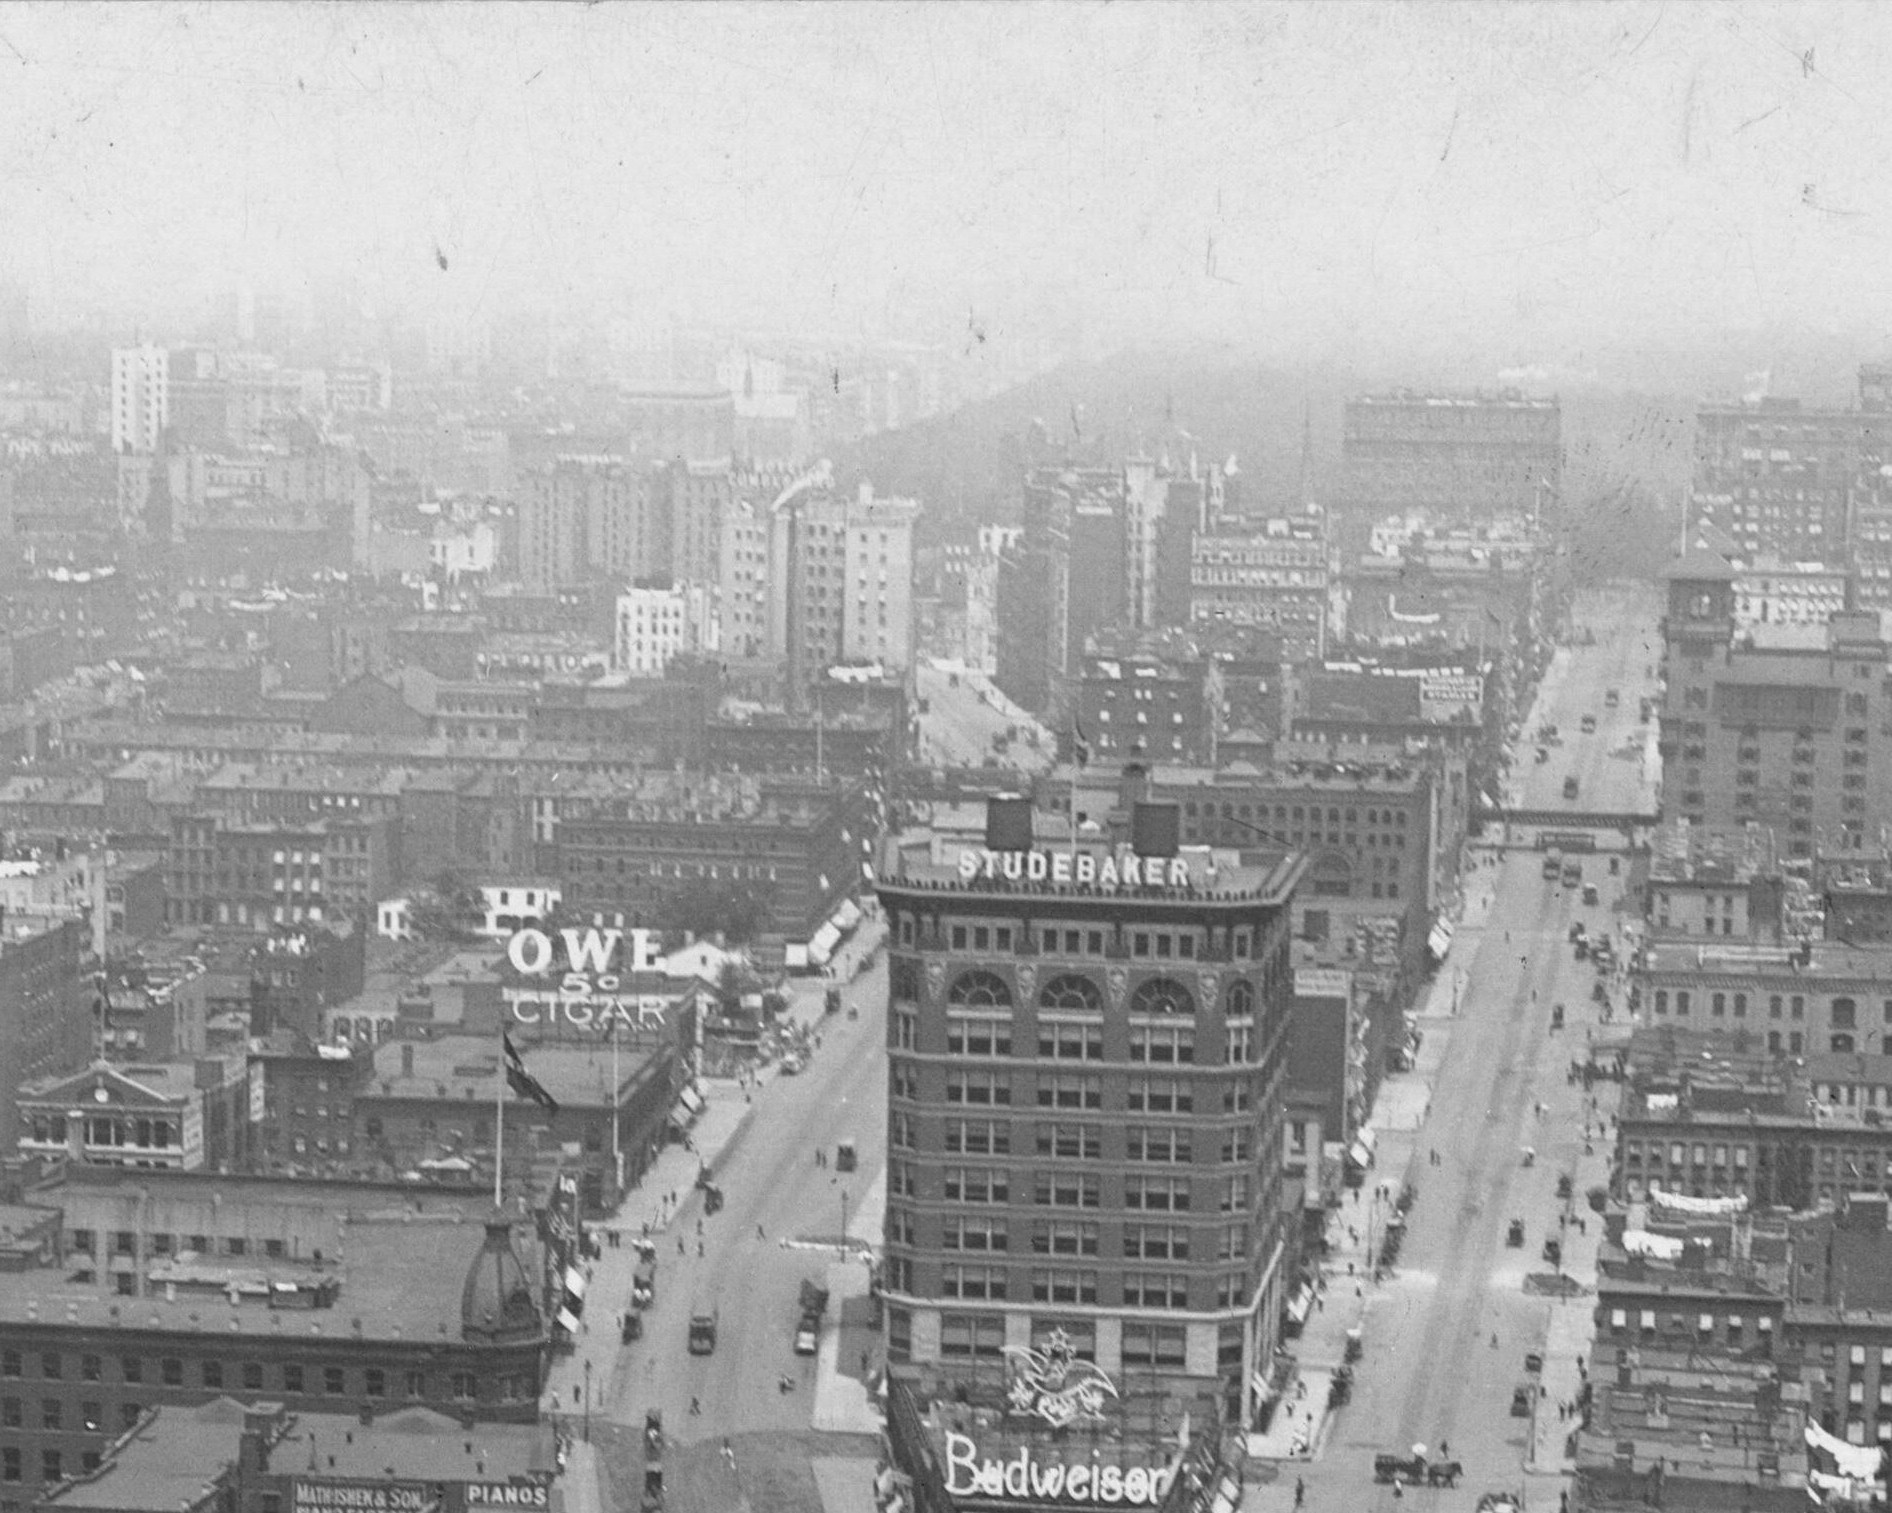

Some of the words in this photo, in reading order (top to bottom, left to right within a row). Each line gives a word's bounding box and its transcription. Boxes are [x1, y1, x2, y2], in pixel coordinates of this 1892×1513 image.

[959, 850, 1188, 886] STUDEBAKER
[512, 995, 668, 1029] CIGAR
[944, 1430, 1172, 1503] Budweiser
[469, 1484, 548, 1506] PIANOS
